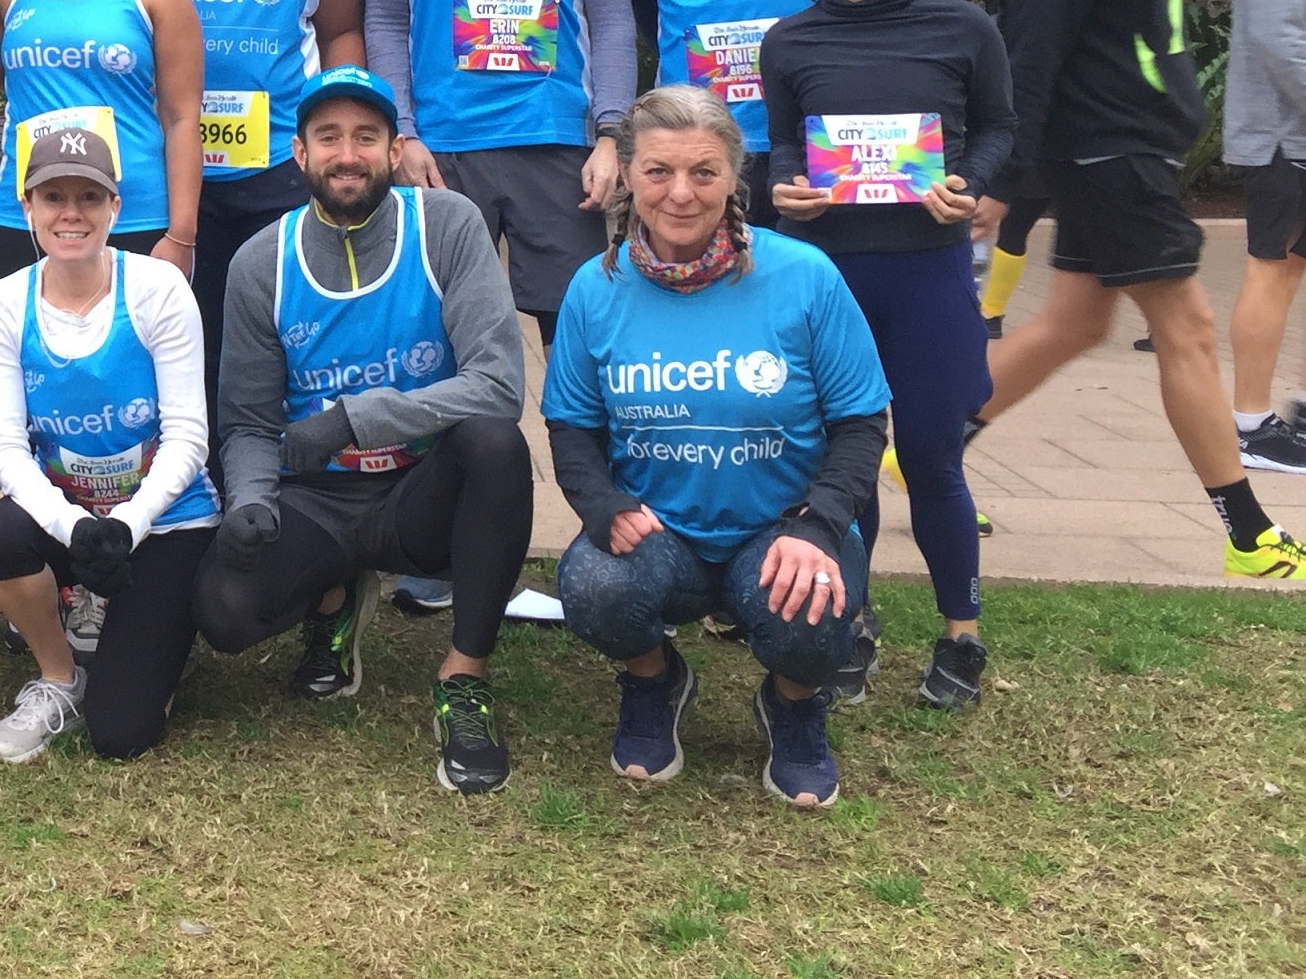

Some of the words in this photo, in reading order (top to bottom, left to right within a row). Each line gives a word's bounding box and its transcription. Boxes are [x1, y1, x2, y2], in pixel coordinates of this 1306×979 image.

[489, 19, 519, 34] ERIN
[239, 36, 278, 56] child
[708, 32, 766, 47] CITY2SUR
[3, 38, 96, 70] unicef
[60, 132, 87, 155] NY
[294, 348, 398, 391] unicef
[606, 349, 731, 394] unicef
[615, 404, 691, 420] AUSTRALIA
[627, 434, 651, 459] for
[652, 442, 724, 470] every
[730, 436, 785, 466] child
[71, 472, 139, 490] JENNIFER
